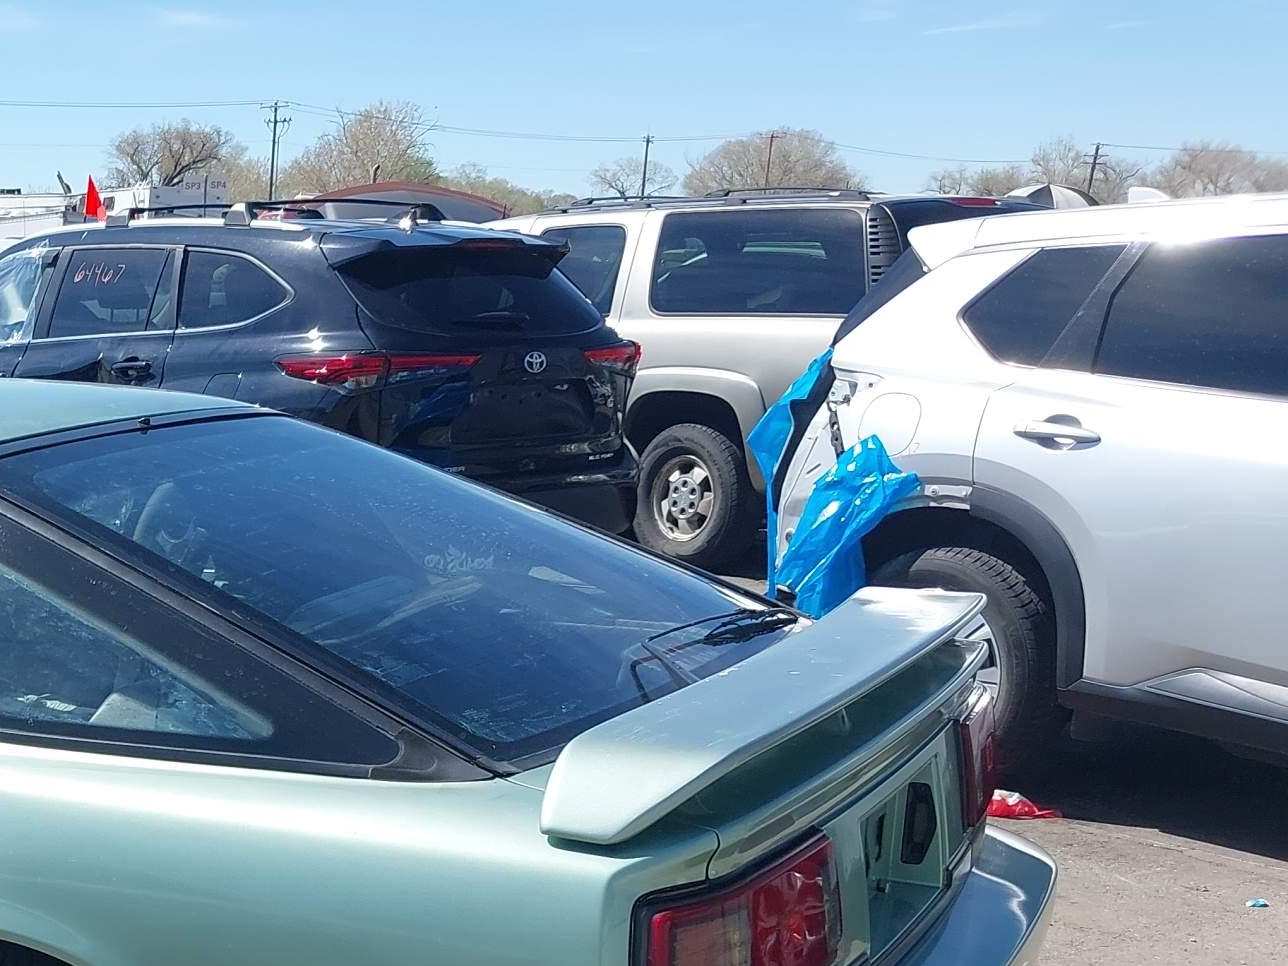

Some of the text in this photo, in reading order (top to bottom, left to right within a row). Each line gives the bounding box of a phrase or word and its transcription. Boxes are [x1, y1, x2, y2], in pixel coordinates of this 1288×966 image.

[185, 182, 201, 190] SP3
[210, 181, 226, 189] SP4
[73, 262, 126, 288] 64467
